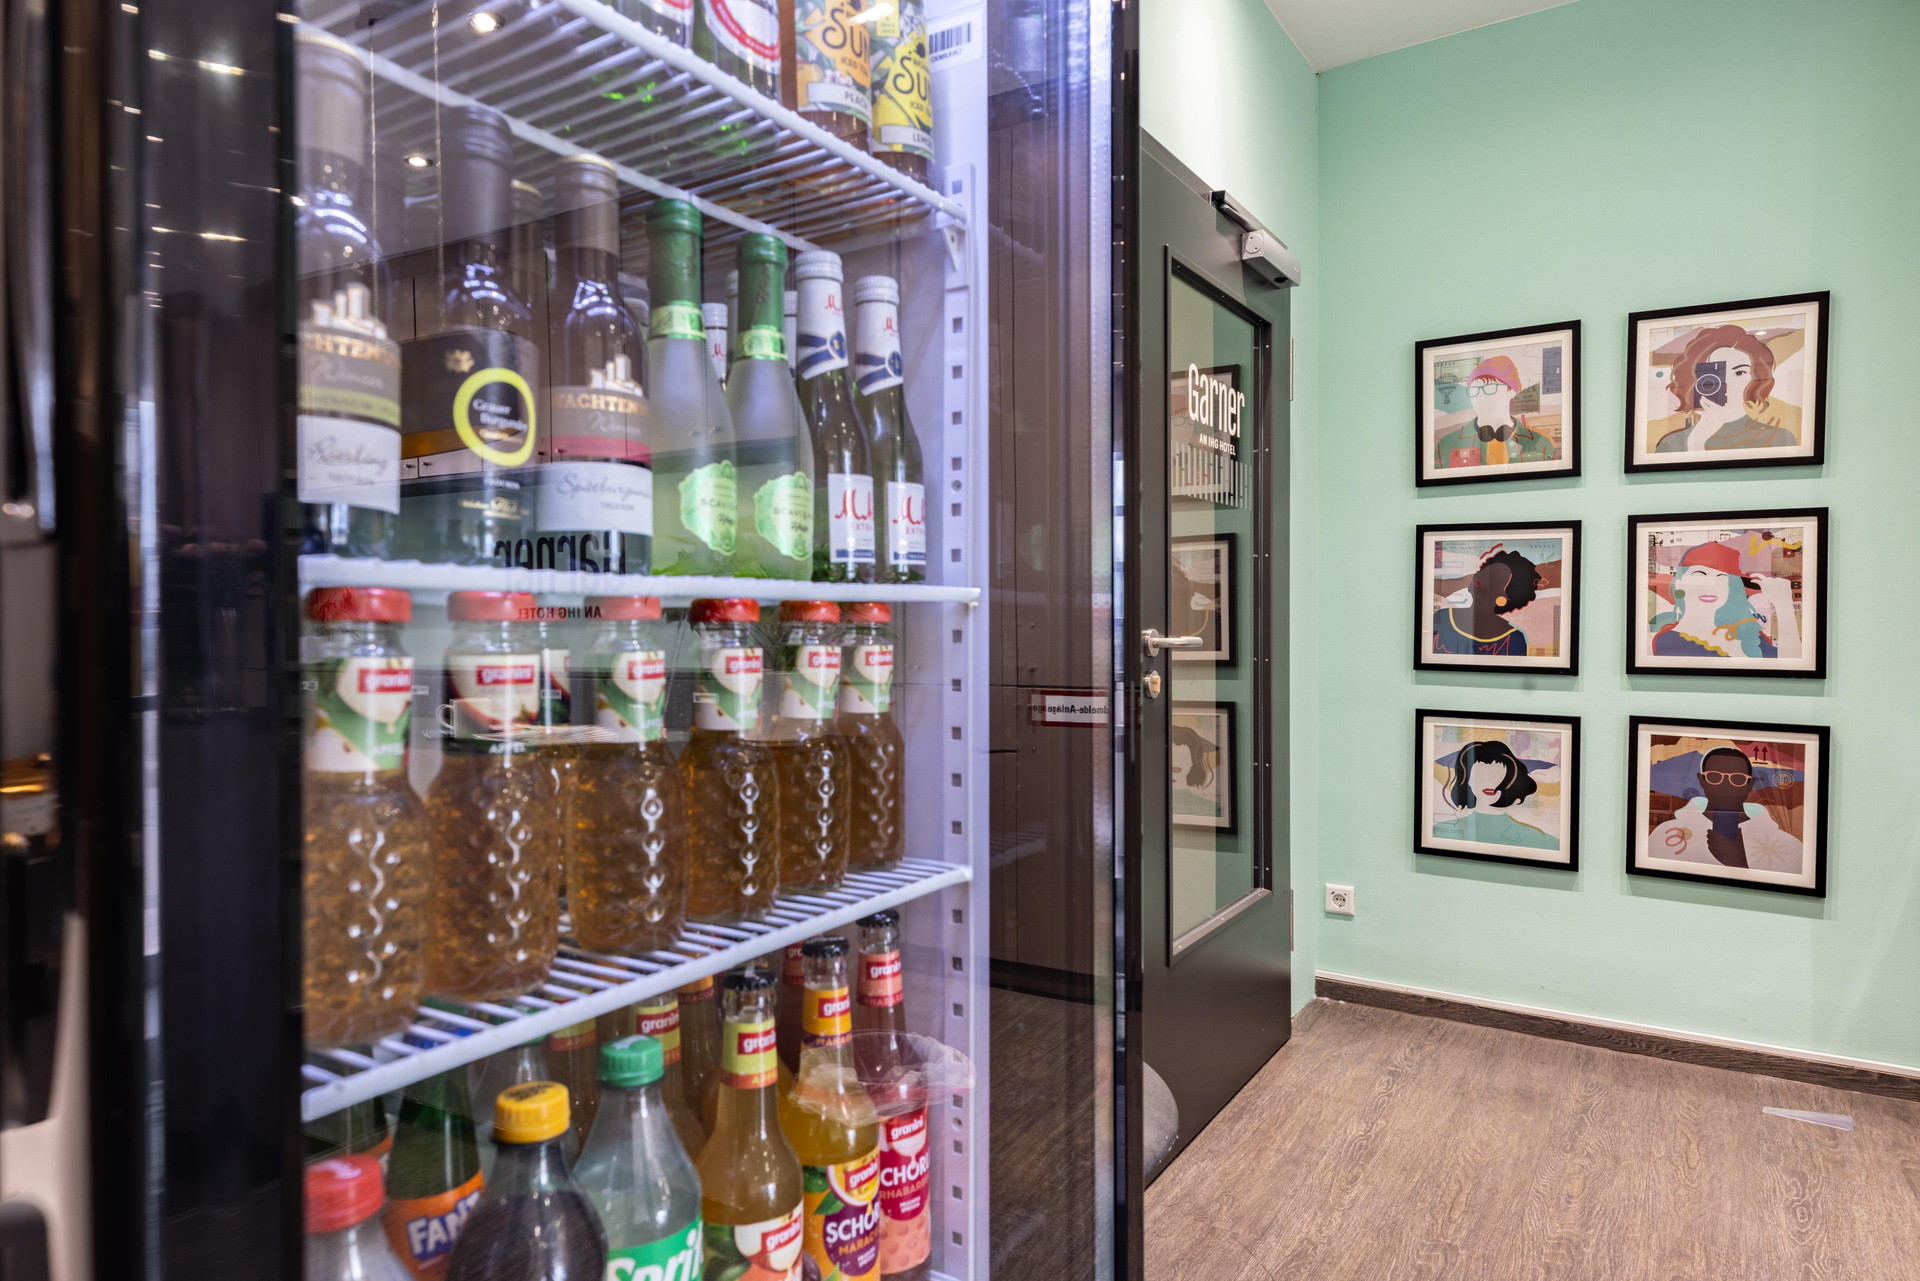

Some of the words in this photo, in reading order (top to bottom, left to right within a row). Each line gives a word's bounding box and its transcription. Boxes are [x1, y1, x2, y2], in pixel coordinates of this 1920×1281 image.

[1188, 363, 1245, 438] Garner
[1199, 433, 1207, 444] AN
[1208, 436, 1219, 450] IHG
[1219, 441, 1236, 456] HOTEL
[891, 1115, 924, 1140] granini
